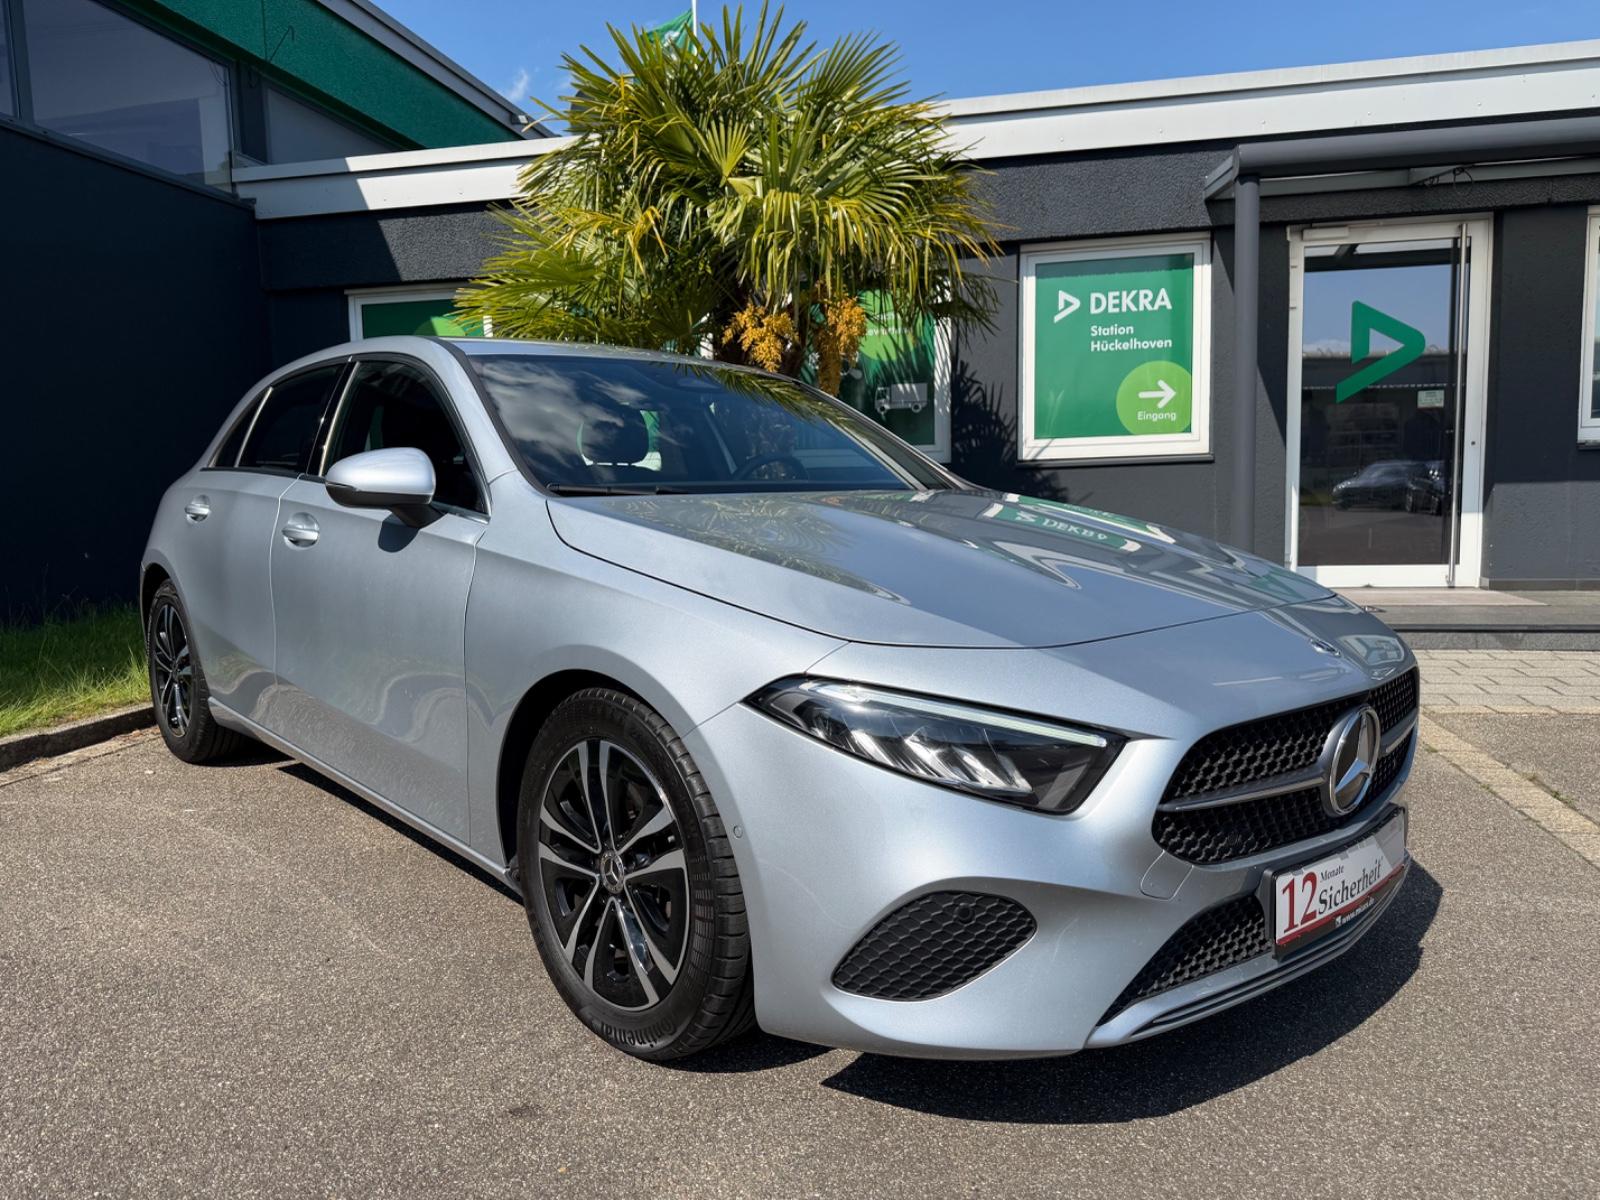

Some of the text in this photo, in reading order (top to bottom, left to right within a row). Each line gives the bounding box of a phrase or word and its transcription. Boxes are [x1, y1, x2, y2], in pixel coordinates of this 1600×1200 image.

[1090, 288, 1172, 314] DEKRA
[1091, 324, 1134, 336] Station
[1091, 338, 1172, 351] Hückelhoven
[1137, 411, 1177, 421] Eingang
[1282, 871, 1317, 933] 12
[1320, 865, 1344, 881] Monate
